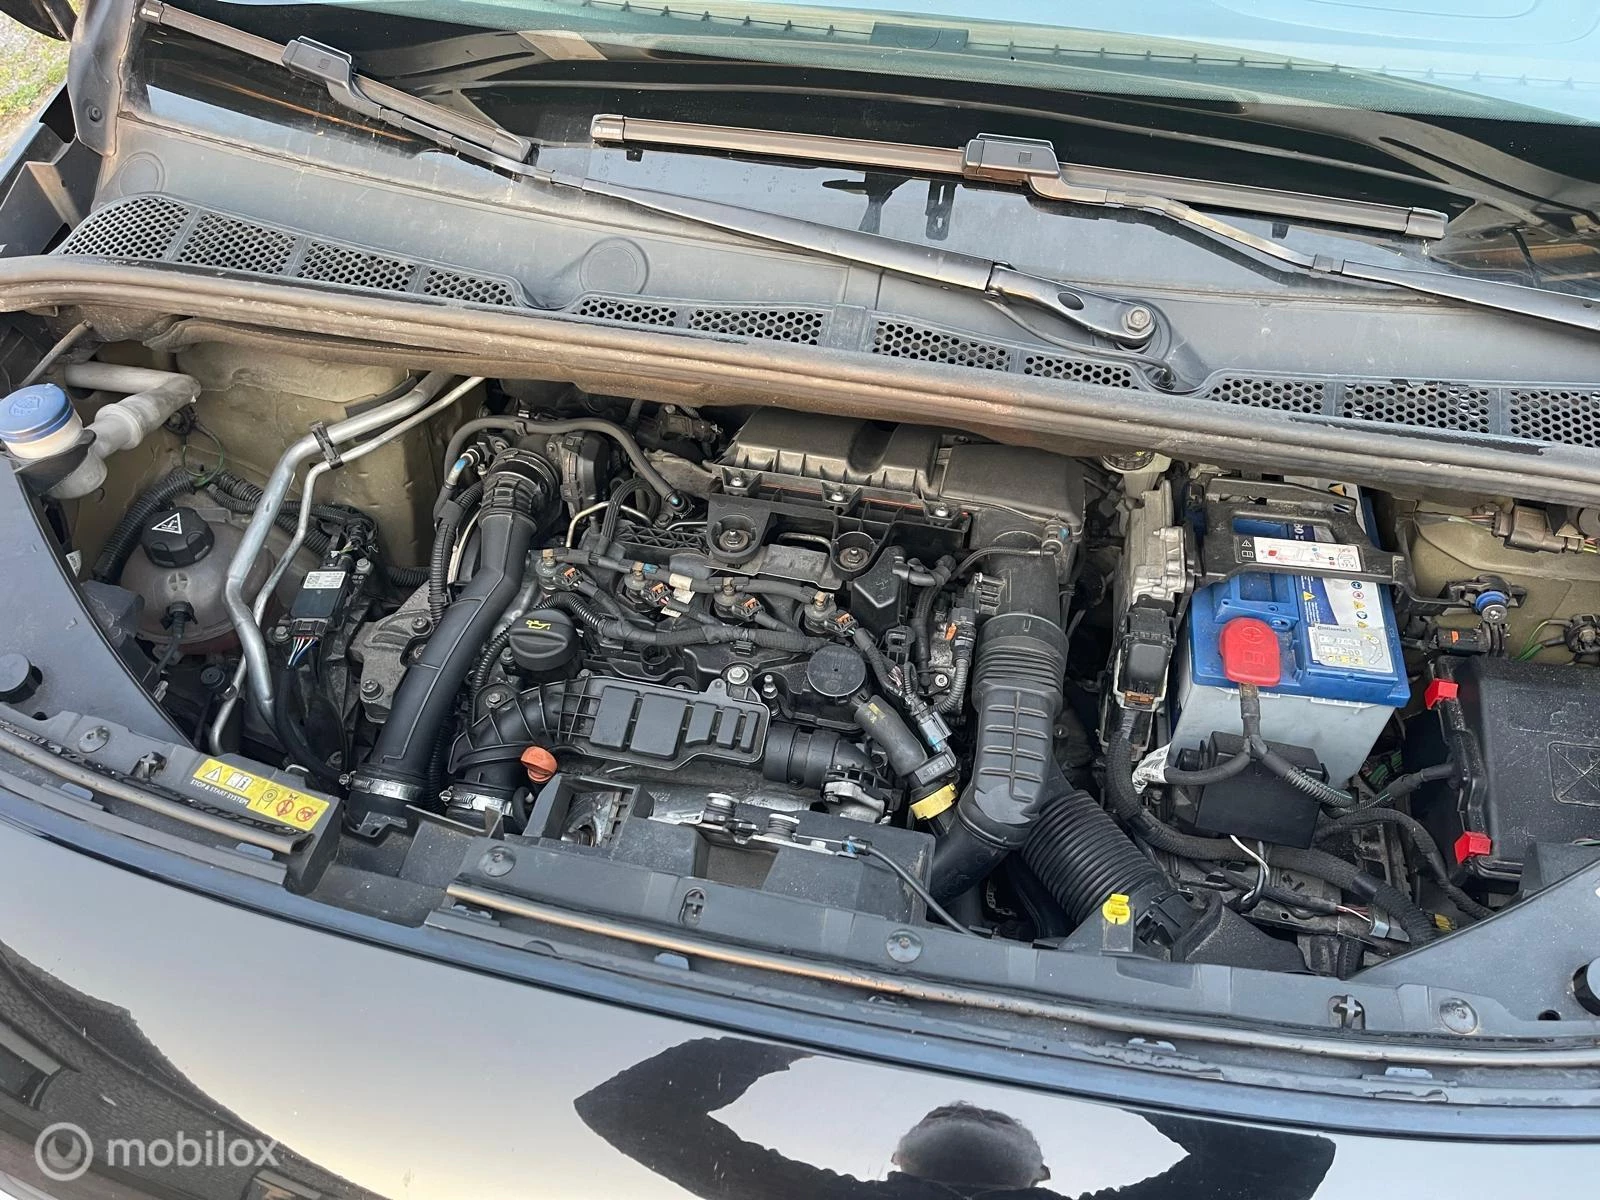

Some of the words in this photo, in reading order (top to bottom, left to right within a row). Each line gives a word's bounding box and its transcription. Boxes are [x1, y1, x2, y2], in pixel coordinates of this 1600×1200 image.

[190, 779, 206, 788] STOP
[210, 786, 228, 797] START
[227, 793, 249, 805] SYSTEM
